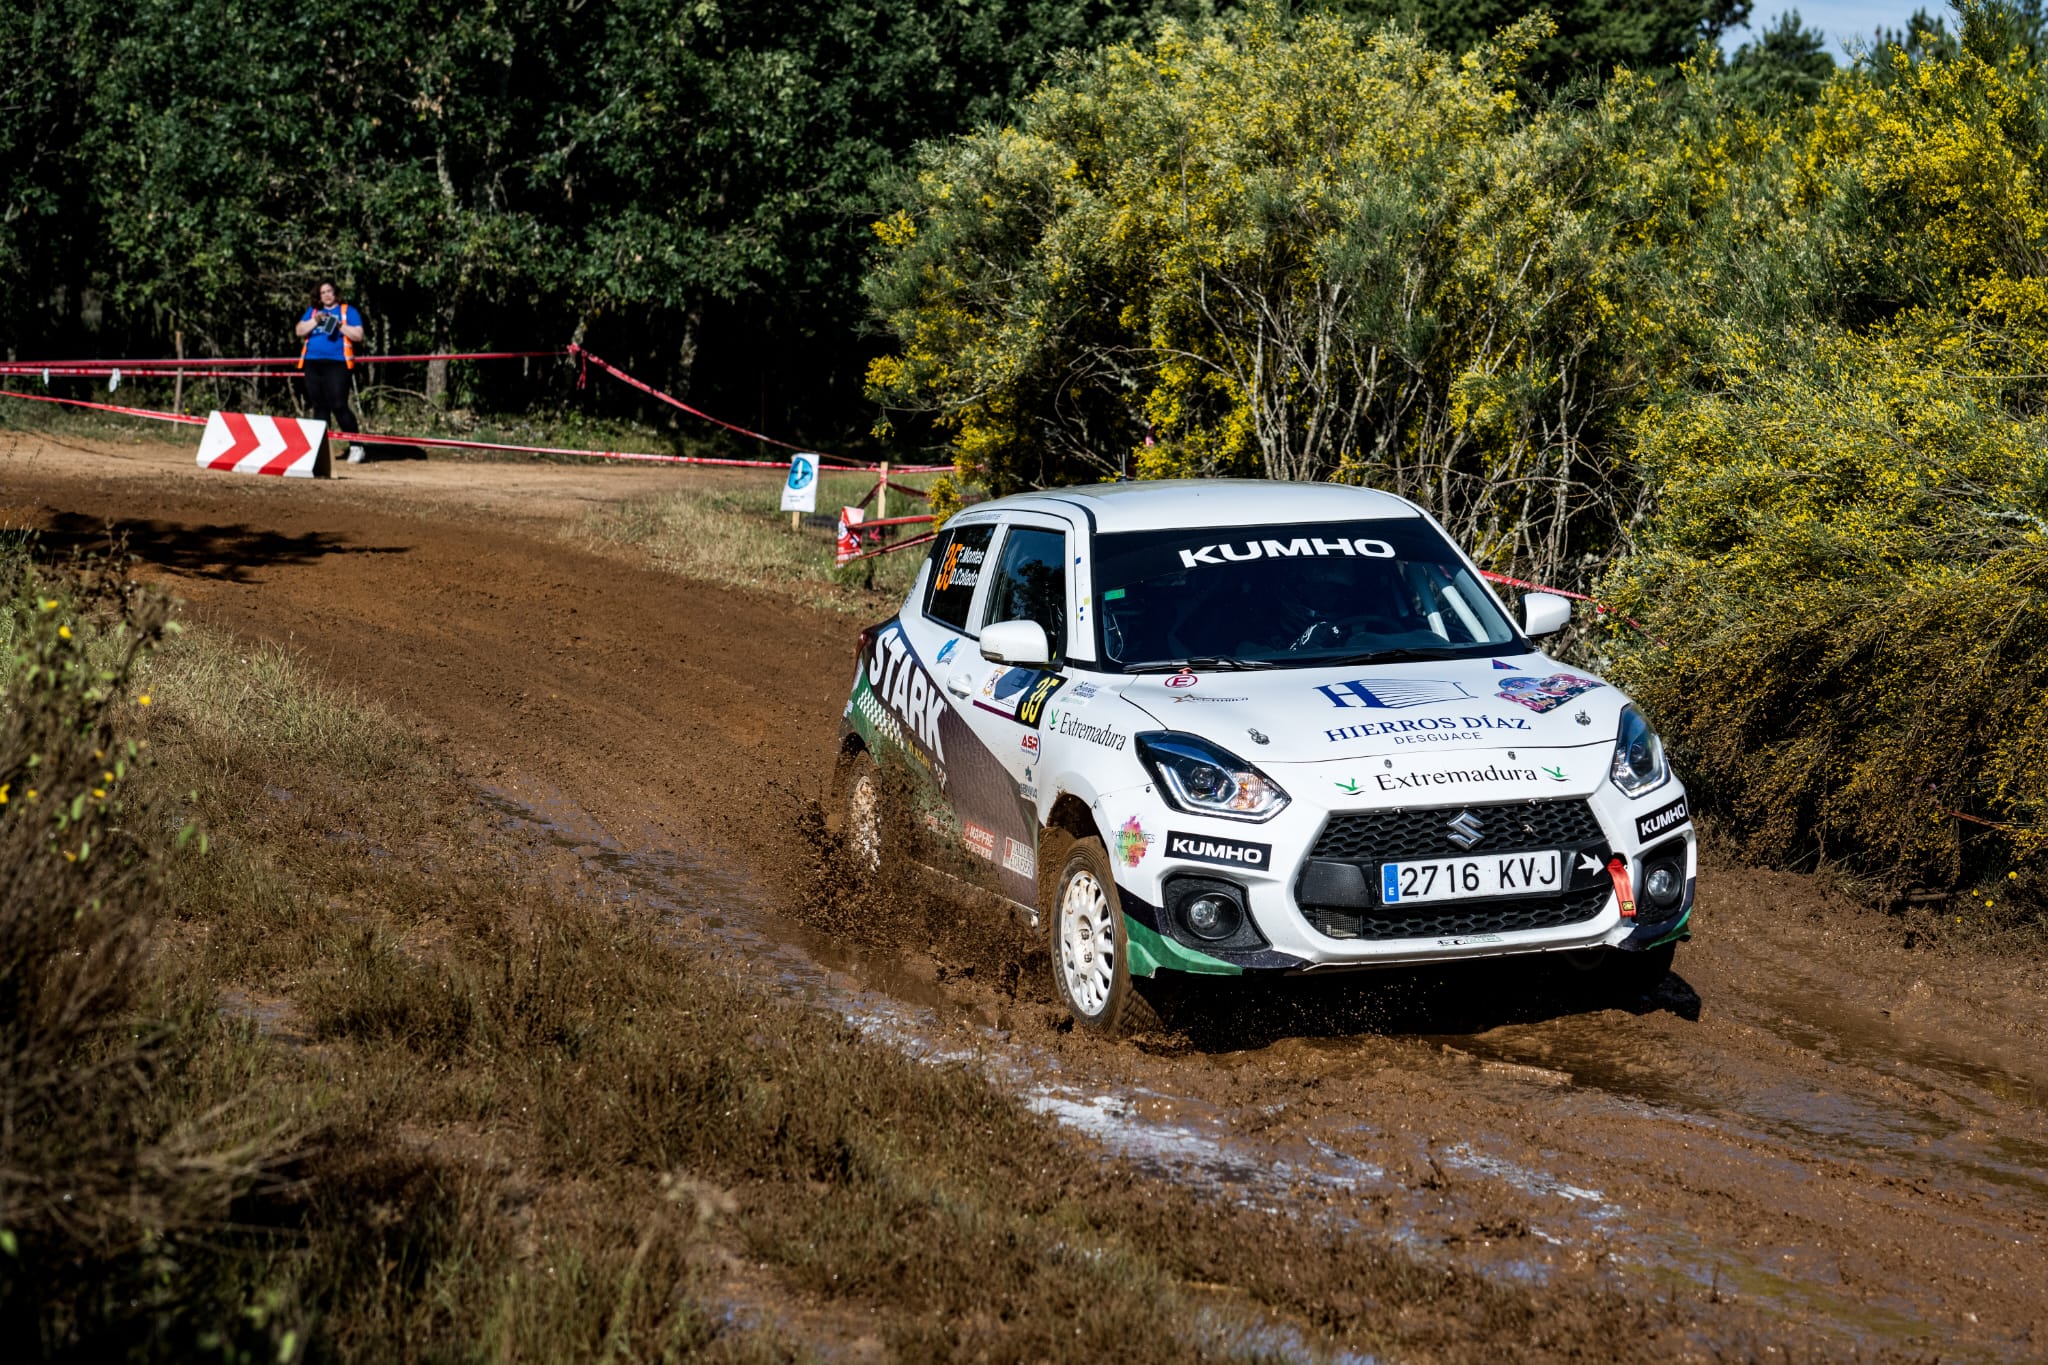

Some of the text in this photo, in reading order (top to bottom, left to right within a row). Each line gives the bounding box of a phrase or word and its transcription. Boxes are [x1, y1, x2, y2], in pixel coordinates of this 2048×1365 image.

[936, 543, 964, 591] 35
[1179, 537, 1396, 568] KUMHO
[869, 627, 946, 766] STARK
[1021, 676, 1060, 723] 35
[1021, 733, 1039, 752] ASR
[1060, 712, 1127, 752] Extremadura
[1323, 714, 1532, 743] HIERROS DÍAZ
[1393, 732, 1483, 745] DESGUACE
[1374, 765, 1538, 791] Extremadura
[1640, 801, 1687, 838] KUMHO
[1172, 837, 1263, 865] KUMHO
[1401, 855, 1557, 897] 2716 KVJ
